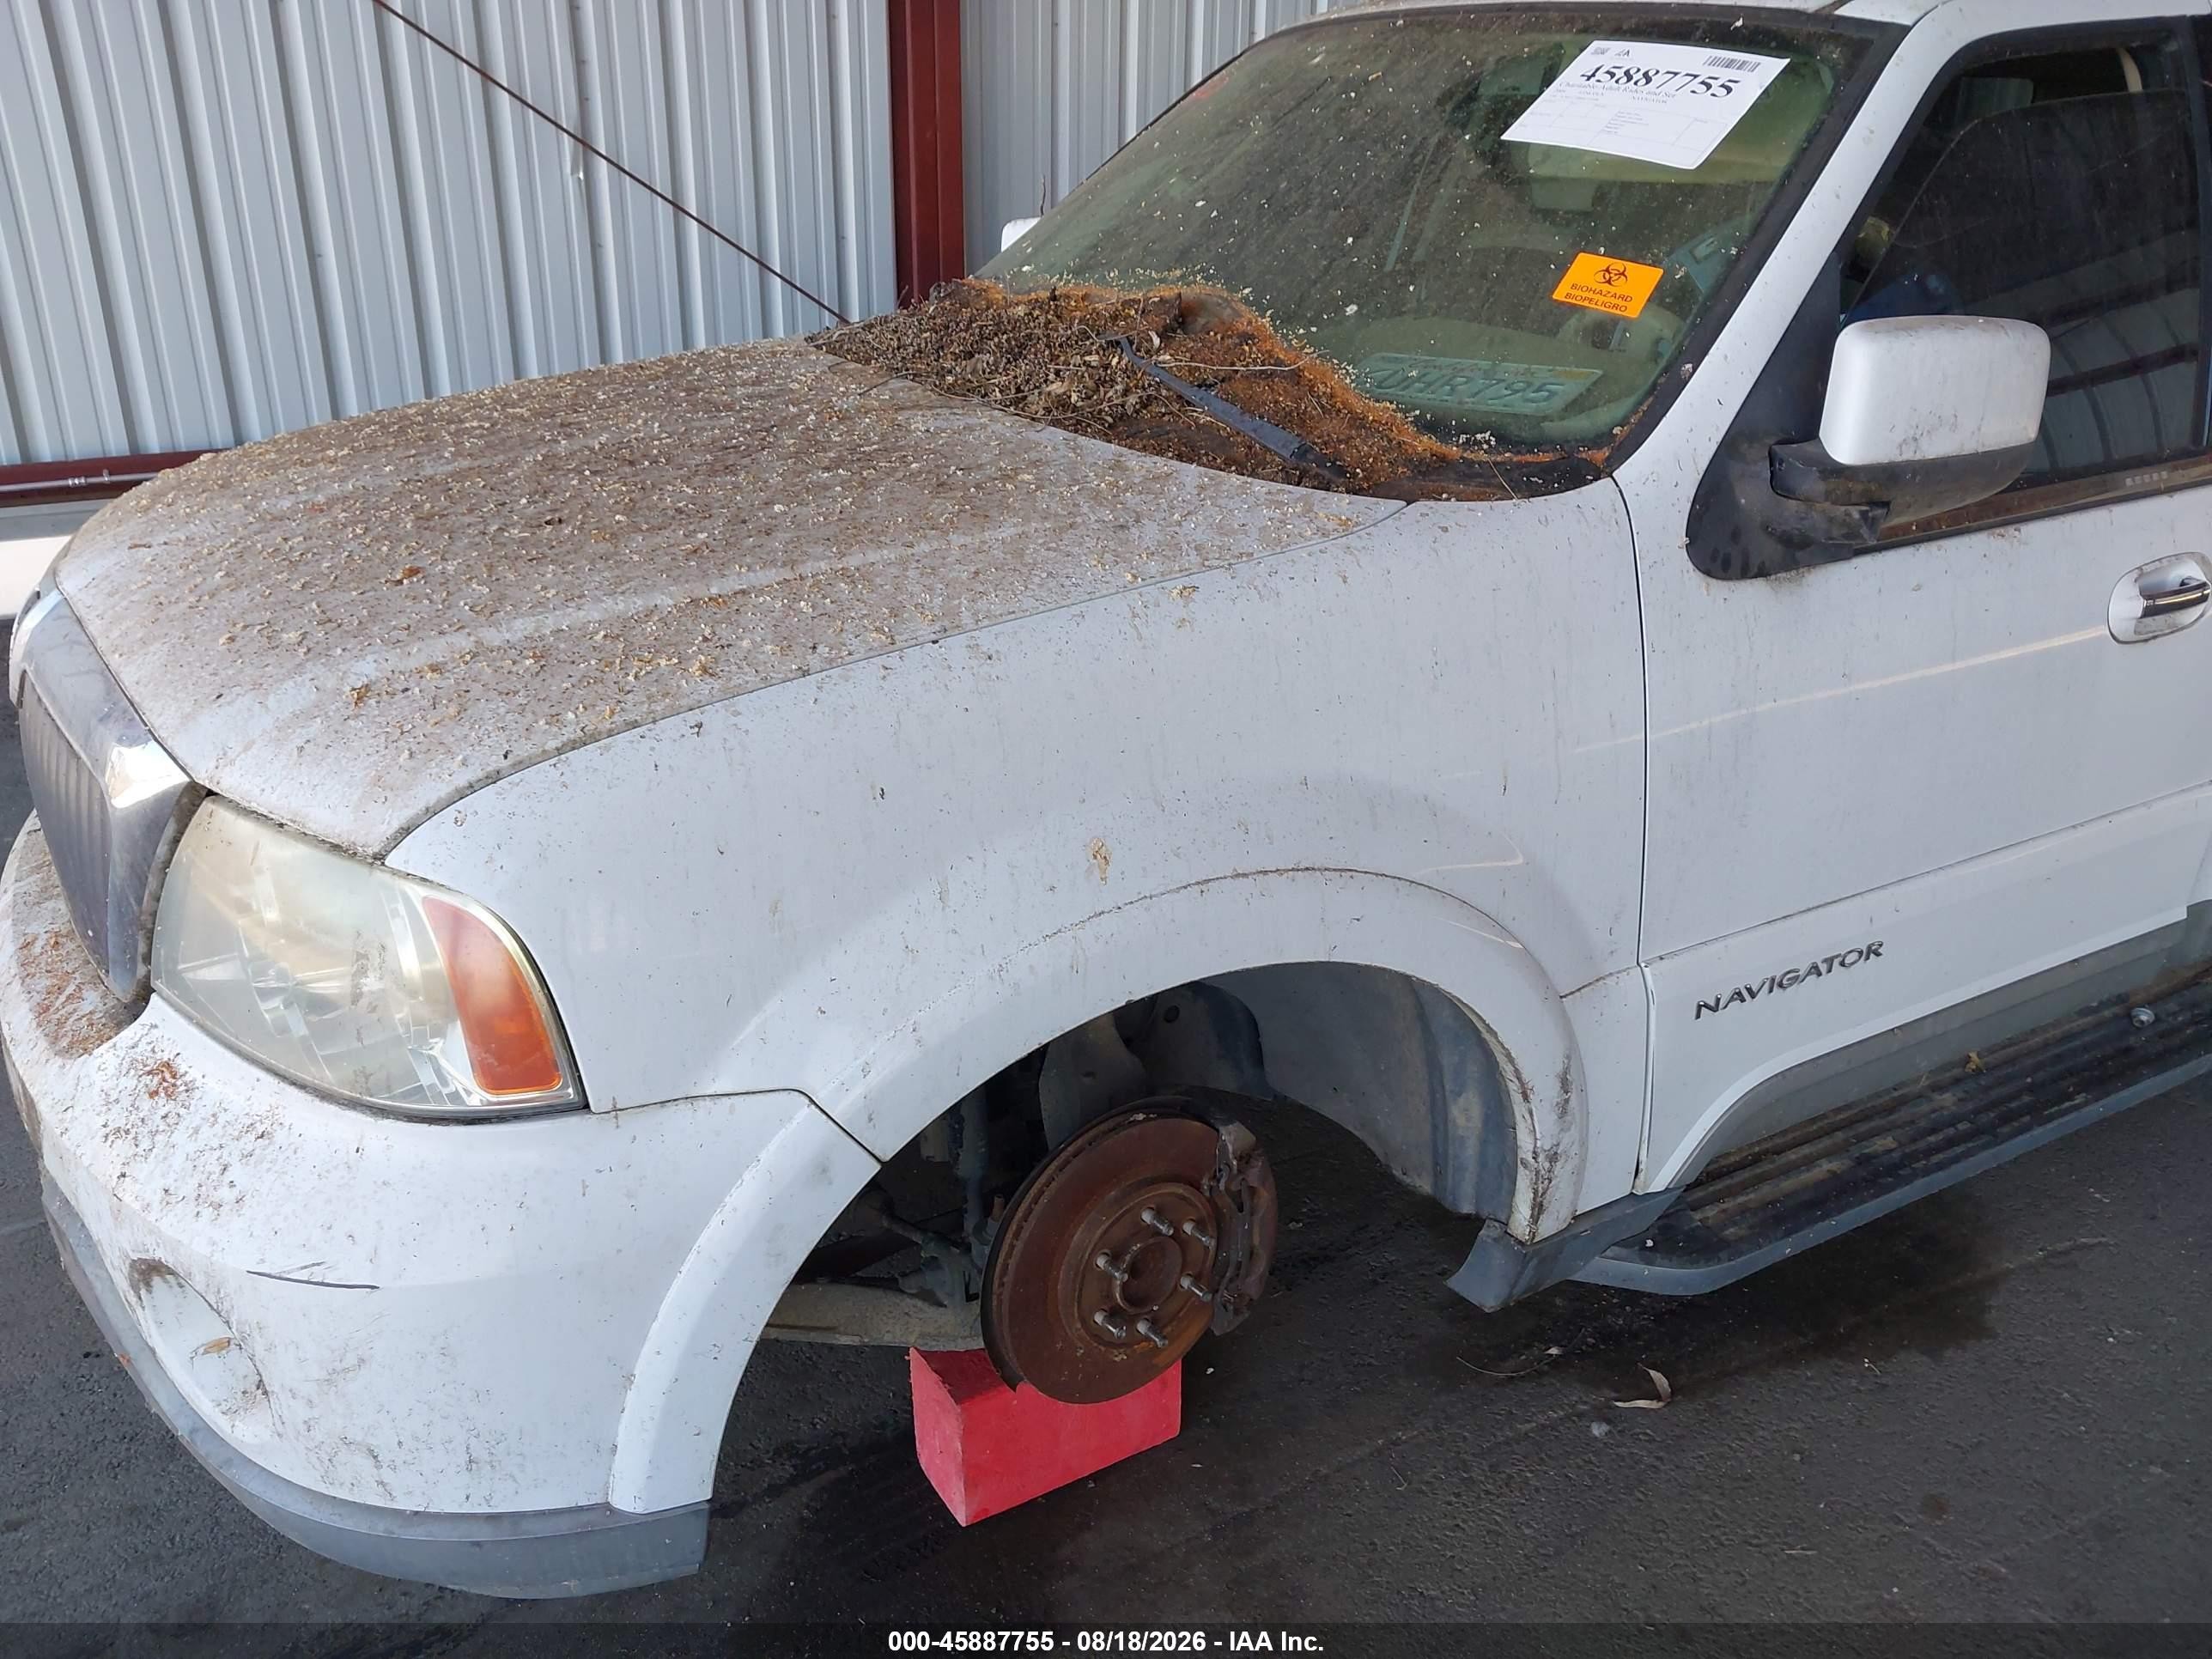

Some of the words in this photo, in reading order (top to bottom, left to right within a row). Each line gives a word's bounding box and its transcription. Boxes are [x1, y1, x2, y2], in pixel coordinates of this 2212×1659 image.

[1580, 64, 1741, 98] 45887755
[1565, 292, 1628, 313] BIOPELIGRO
[1571, 283, 1633, 302] BIOHAZARD
[1694, 940, 1885, 1020] NAVIGATOR
